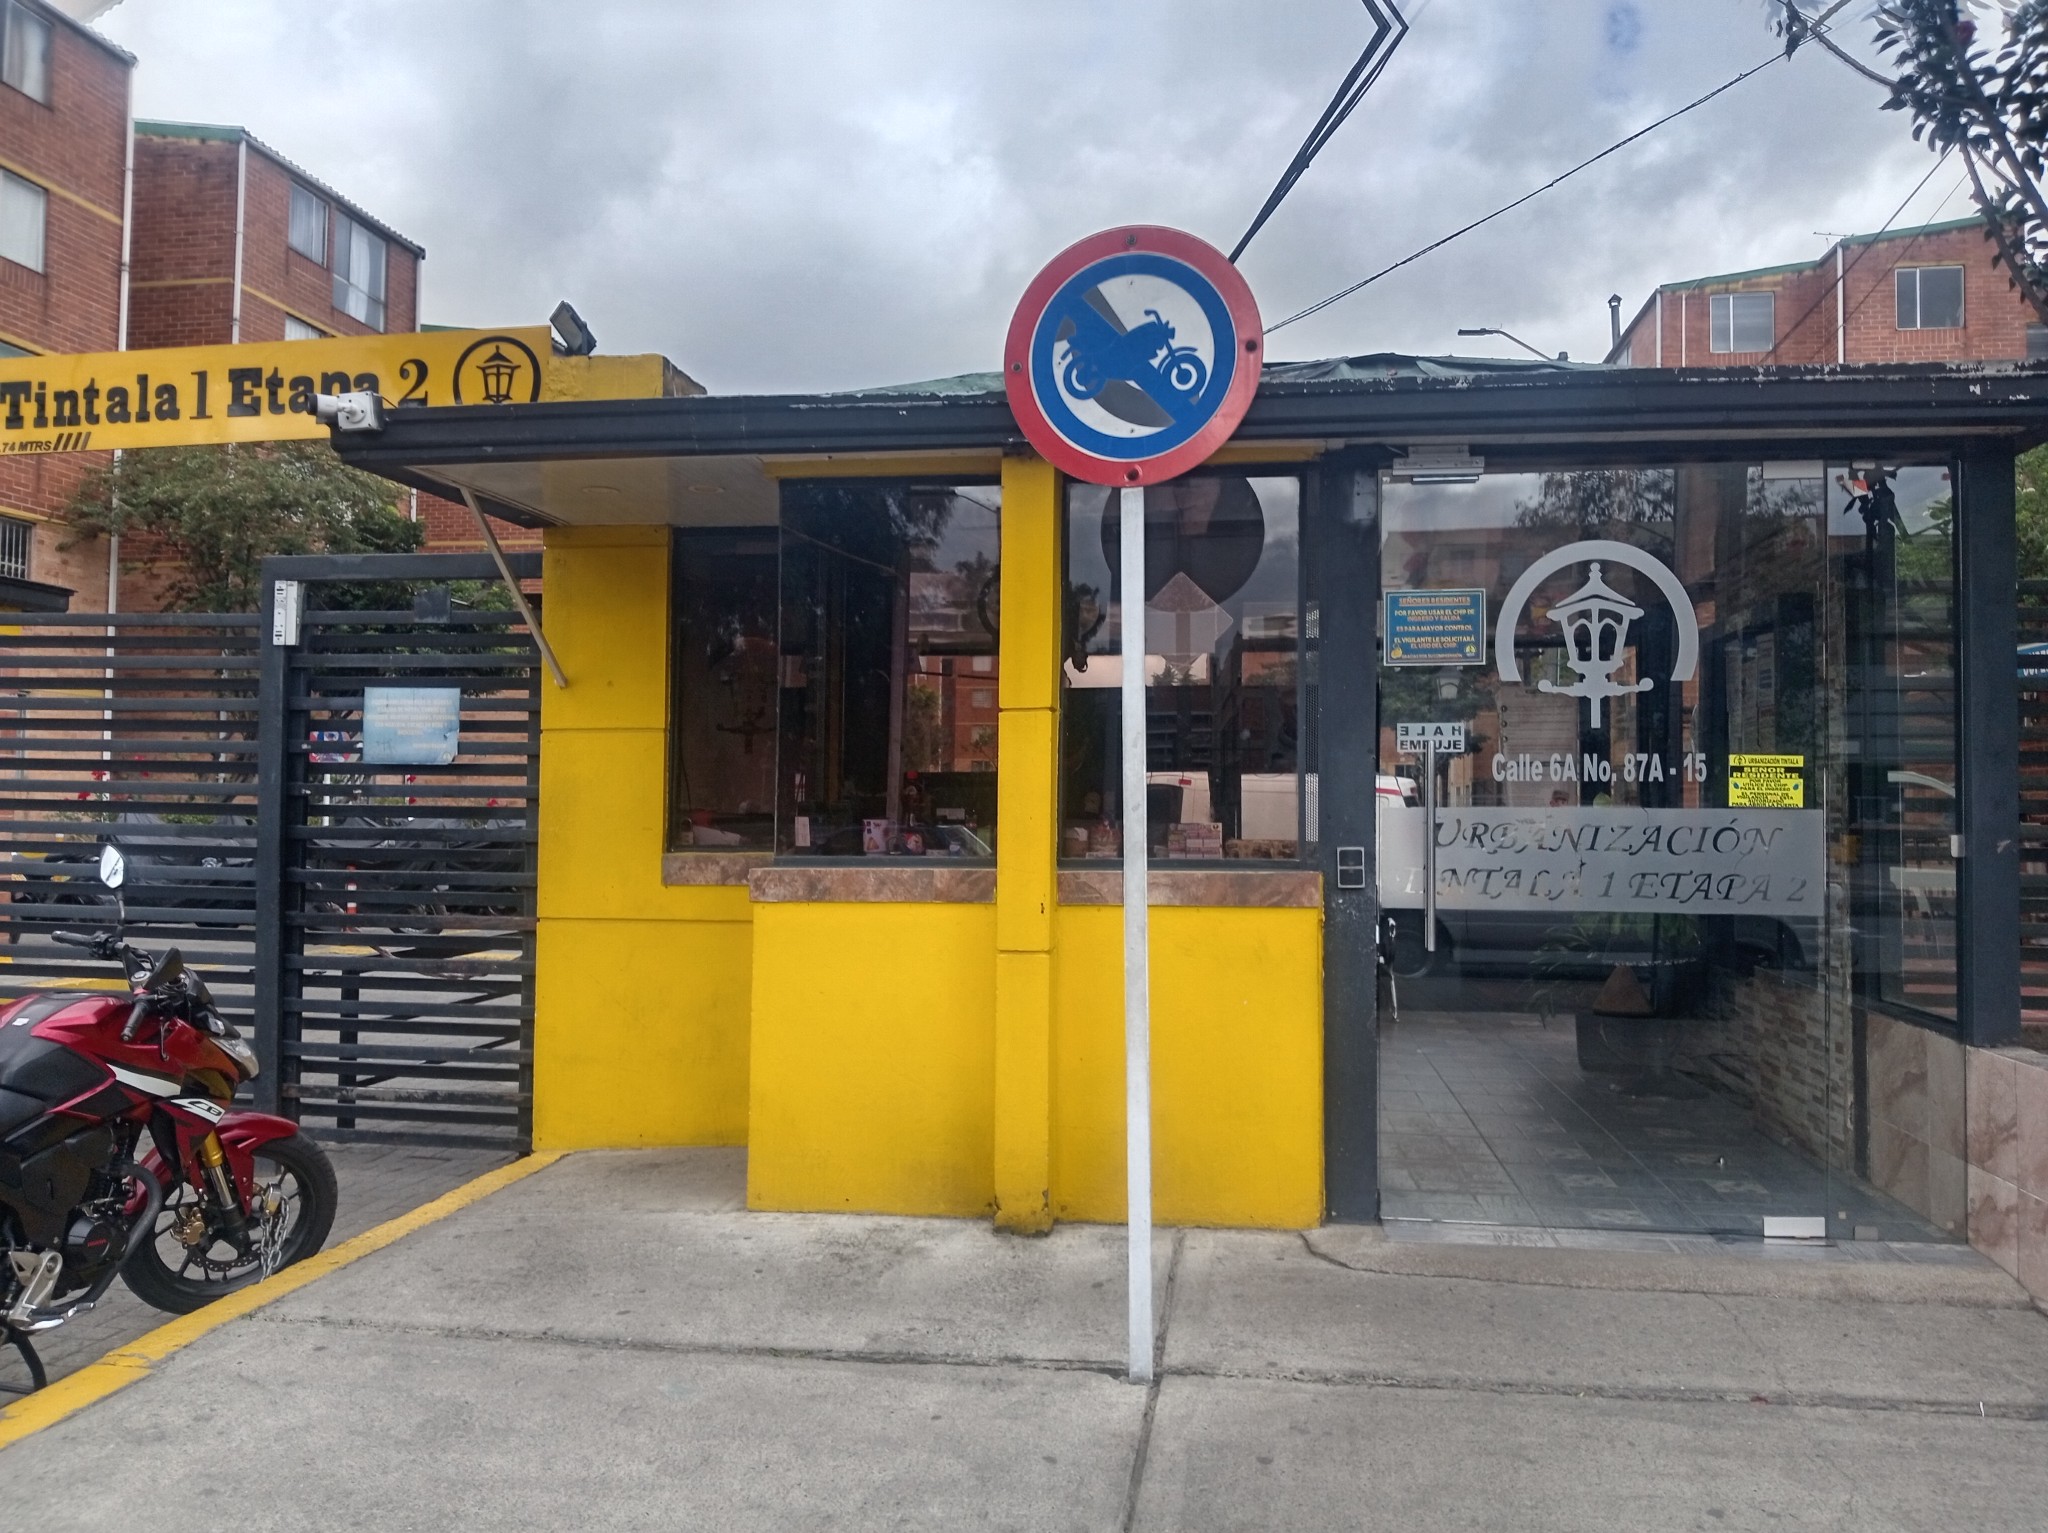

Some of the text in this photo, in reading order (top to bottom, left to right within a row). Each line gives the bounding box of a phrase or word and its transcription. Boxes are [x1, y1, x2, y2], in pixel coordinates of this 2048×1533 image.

[0, 374, 180, 429] Tintala
[190, 370, 213, 420] 1
[398, 358, 428, 406] 2
[18, 440, 52, 452] MTRS
[1492, 753, 1543, 782] Calle
[1550, 753, 1577, 782] 6A
[1583, 753, 1616, 784] No.
[1623, 753, 1663, 782] 87A
[1683, 753, 1707, 782] 15
[1434, 818, 1783, 857] URBANIZACIÓN
[1396, 866, 1807, 904] TNTALA 1 ETAPA 2
